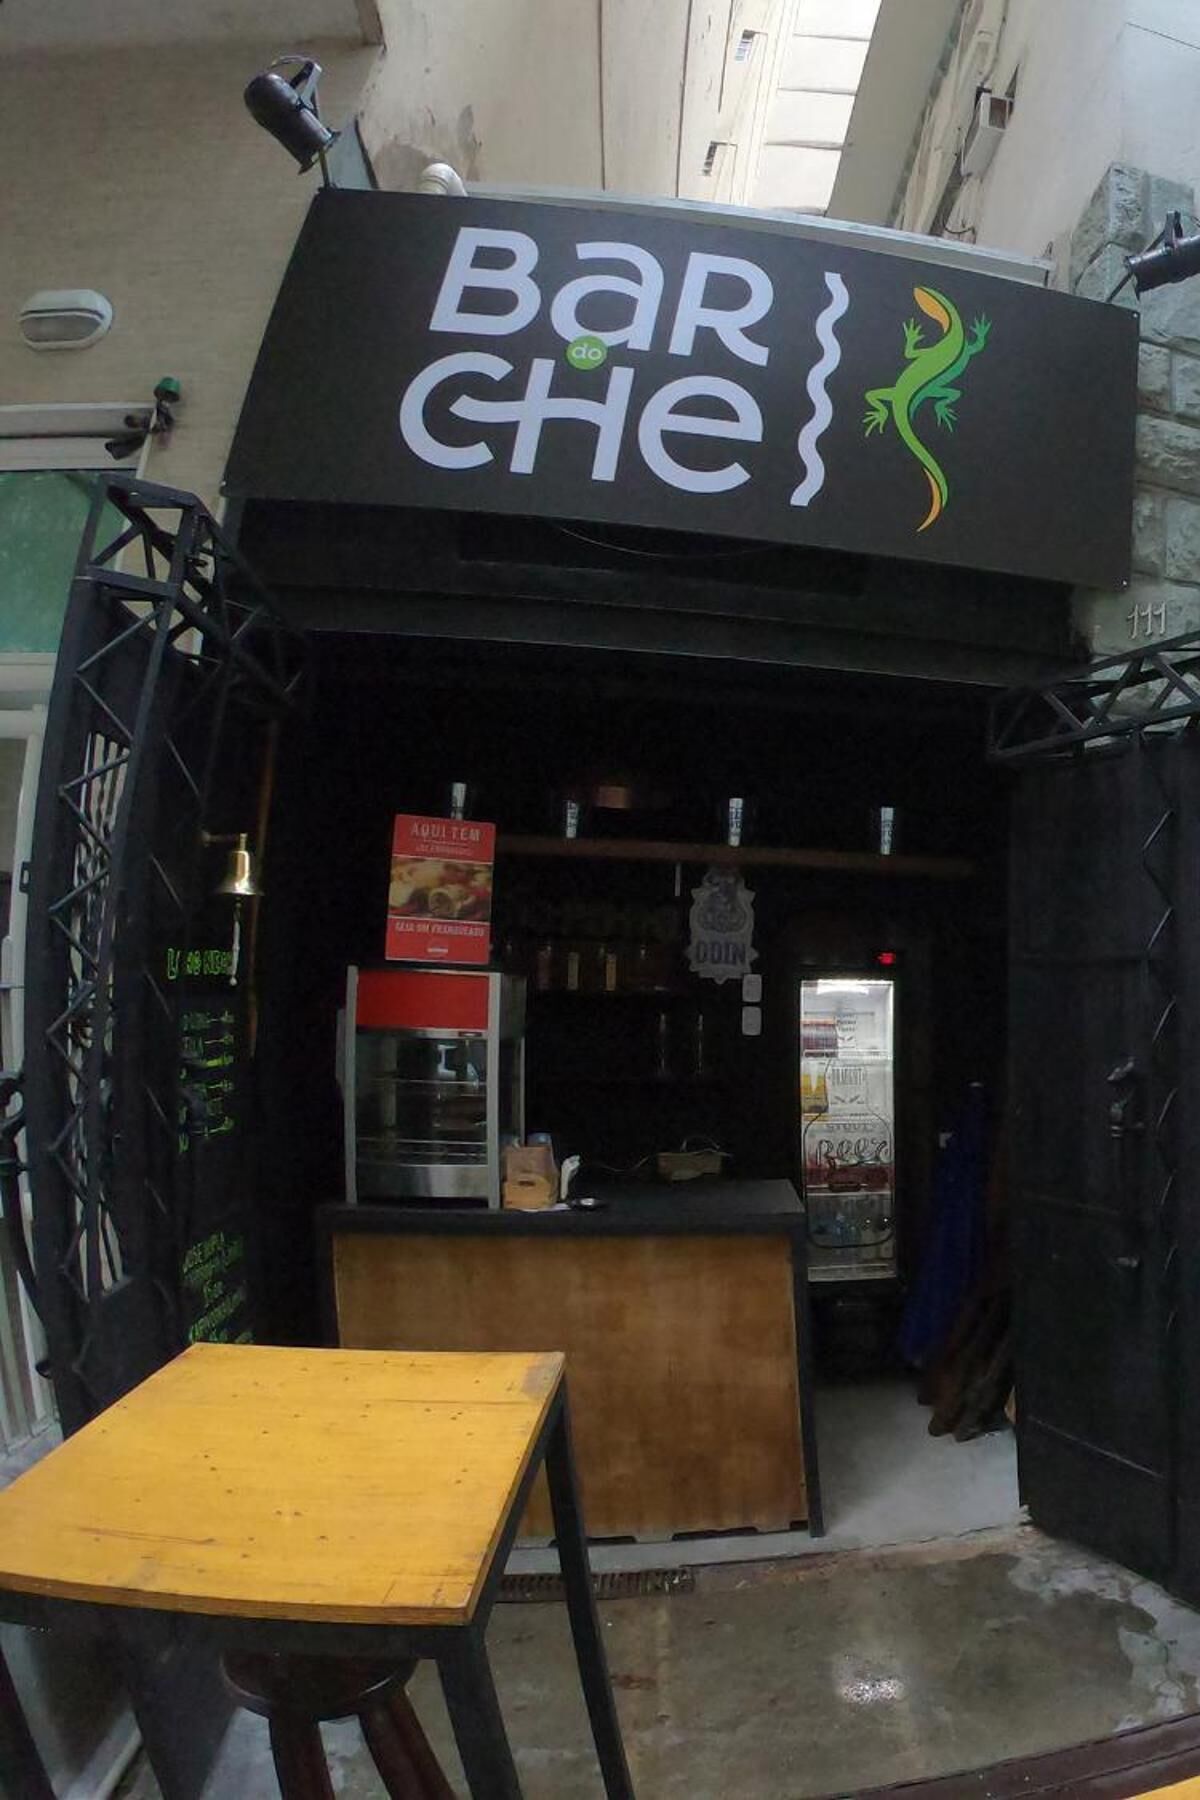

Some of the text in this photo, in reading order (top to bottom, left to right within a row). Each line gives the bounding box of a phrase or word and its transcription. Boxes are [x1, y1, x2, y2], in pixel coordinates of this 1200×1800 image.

[571, 344, 603, 361] do
[410, 822, 481, 842] AQUI TEM
